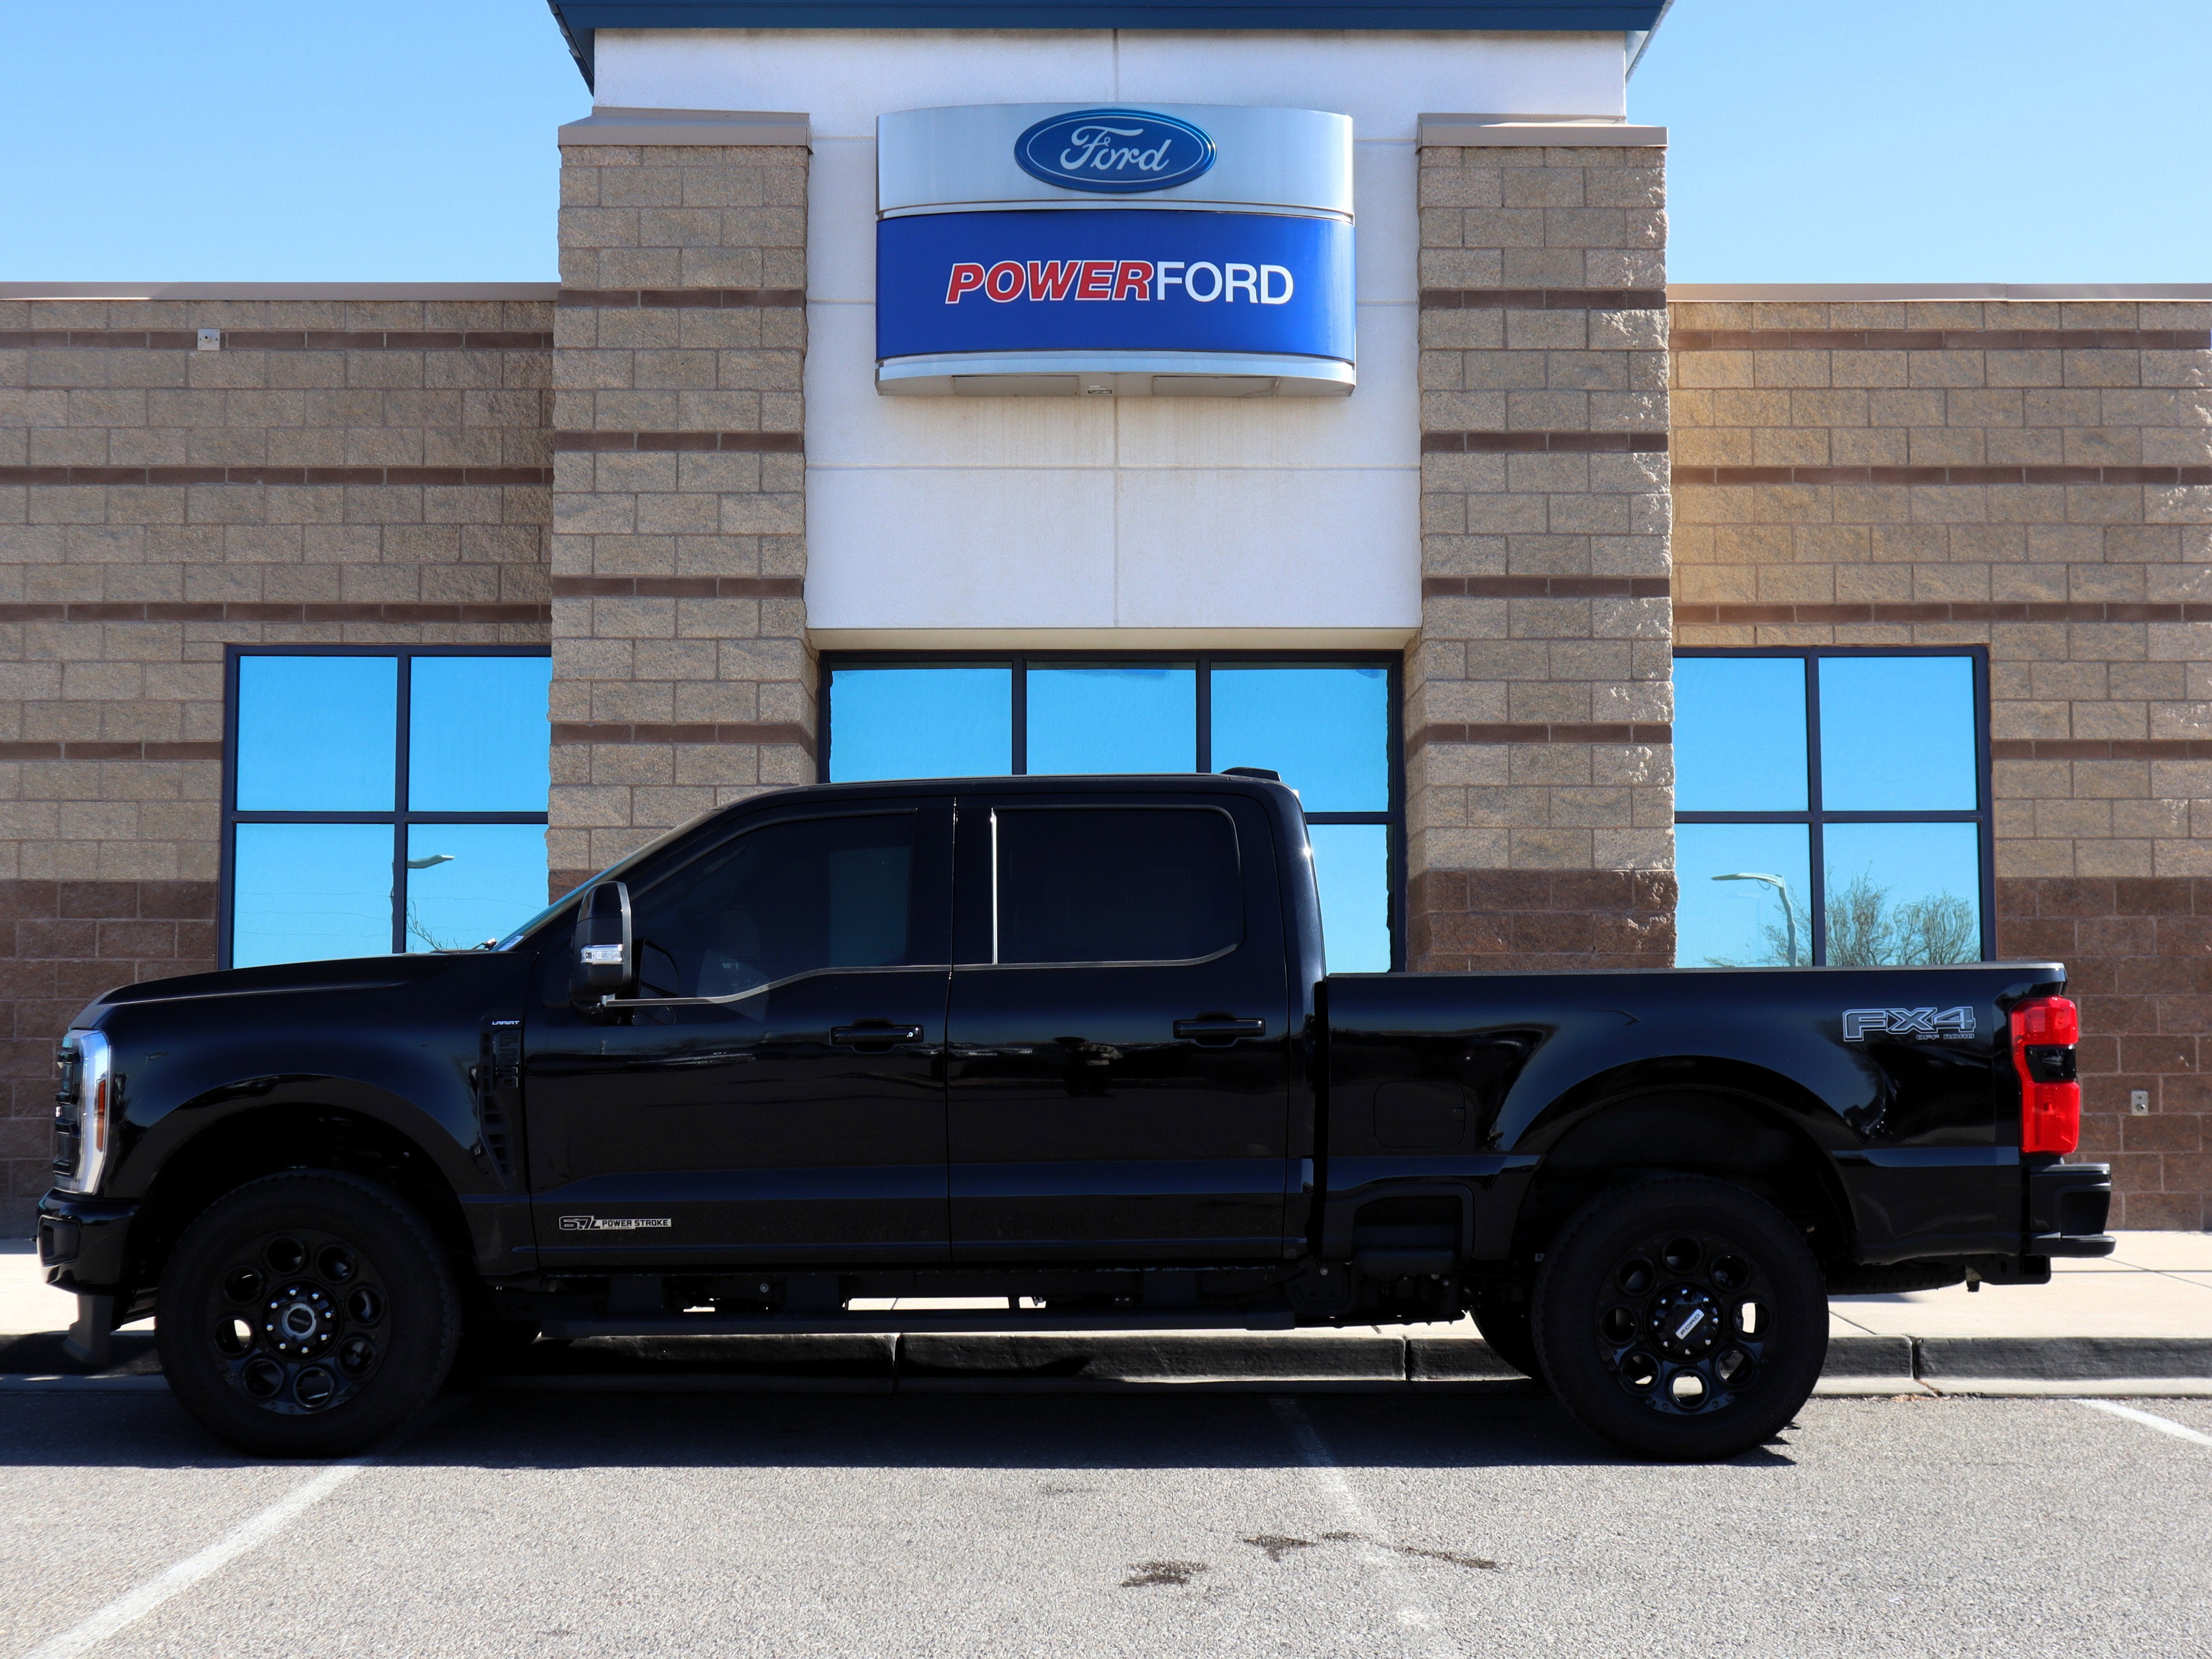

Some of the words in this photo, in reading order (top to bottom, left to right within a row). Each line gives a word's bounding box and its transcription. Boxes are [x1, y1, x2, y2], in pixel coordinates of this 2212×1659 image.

[1059, 125, 1172, 171] Ford
[1843, 1006, 1976, 1042] FX4
[559, 1215, 601, 1230] 6.7L
[1680, 1313, 1700, 1335] FORD
